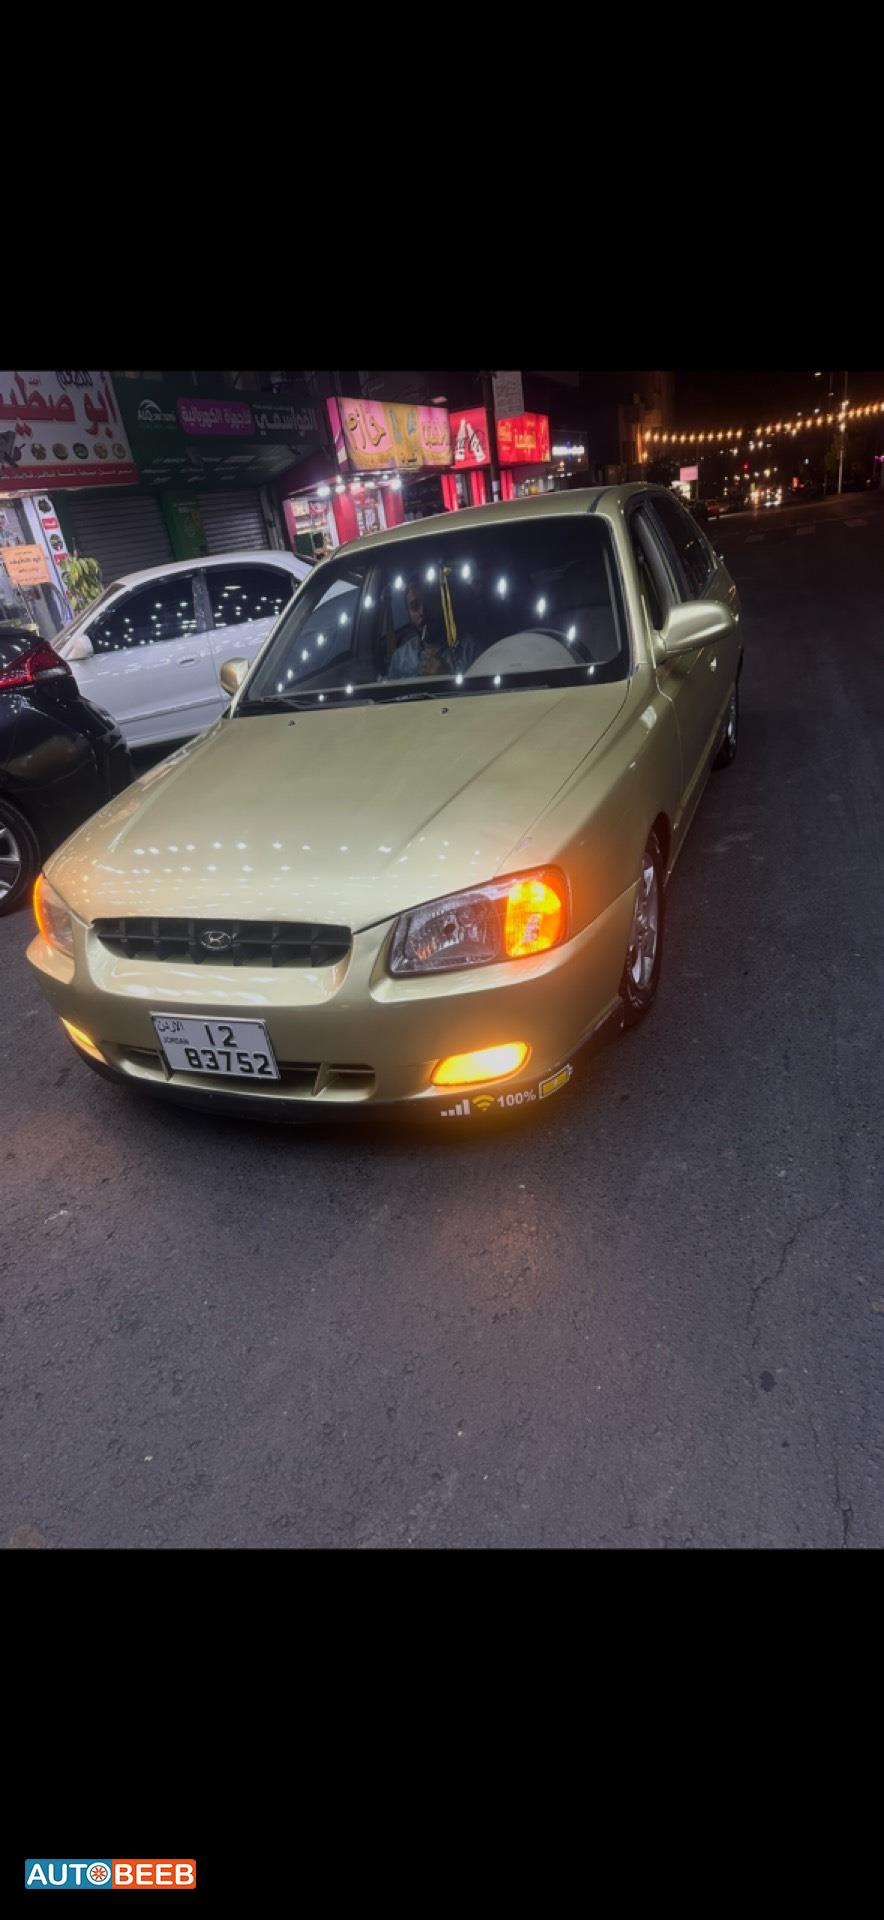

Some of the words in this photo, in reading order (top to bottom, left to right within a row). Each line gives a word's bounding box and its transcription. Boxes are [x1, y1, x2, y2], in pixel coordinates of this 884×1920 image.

[0, 372, 76, 437] صطي
[163, 1036, 189, 1045] JORDAN
[204, 1024, 237, 1048] 12
[184, 1048, 273, 1075] 83752
[497, 1089, 537, 1108] 100%
